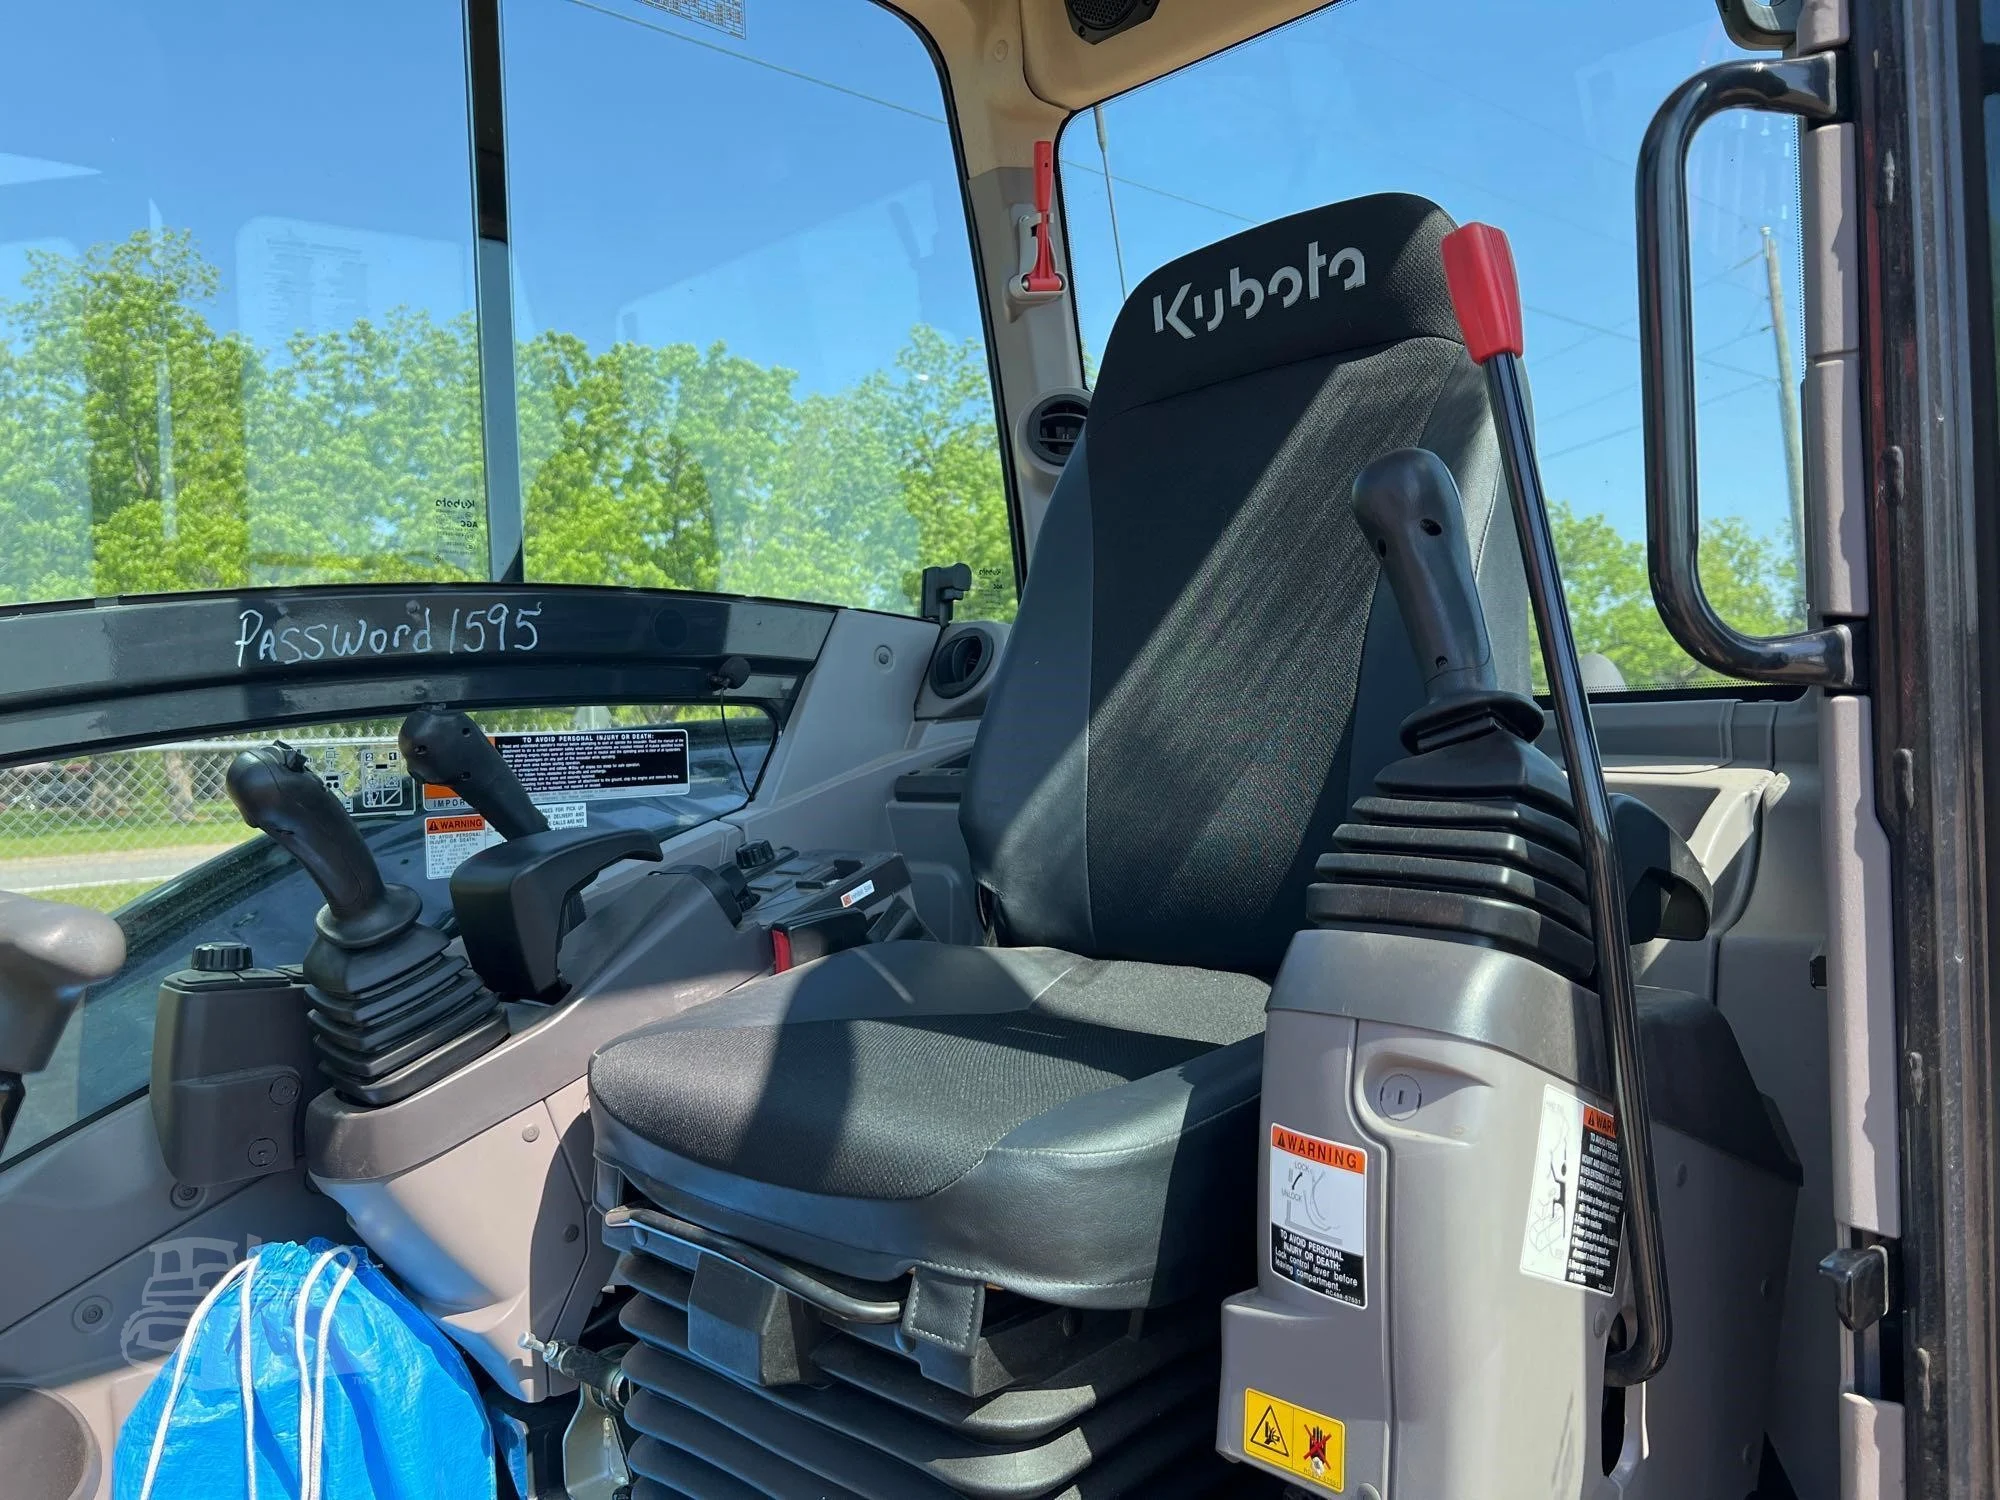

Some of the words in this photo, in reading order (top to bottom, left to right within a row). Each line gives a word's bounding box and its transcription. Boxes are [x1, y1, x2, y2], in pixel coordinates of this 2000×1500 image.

[1152, 241, 1366, 340] Kubota
[449, 601, 543, 654] 1595
[433, 799, 466, 808] IMPOR
[440, 818, 483, 830] WARNING
[1288, 1134, 1357, 1169] WARNING
[1294, 1161, 1310, 1172] LOCK
[1281, 1187, 1302, 1202] UNLOCK
[1280, 1229, 1288, 1240] TO
[1289, 1232, 1306, 1248] AVOID
[1308, 1241, 1344, 1261] PERSONAL
[1284, 1240, 1302, 1257] INJURY
[1304, 1250, 1314, 1262] OR
[1316, 1256, 1341, 1272] DEATH:
[1275, 1246, 1288, 1260] Lock
[1290, 1256, 1310, 1270] control
[1312, 1264, 1330, 1278] lever
[1334, 1271, 1358, 1287] before
[1275, 1256, 1294, 1275] leaving
[1296, 1268, 1342, 1292] compartment.
